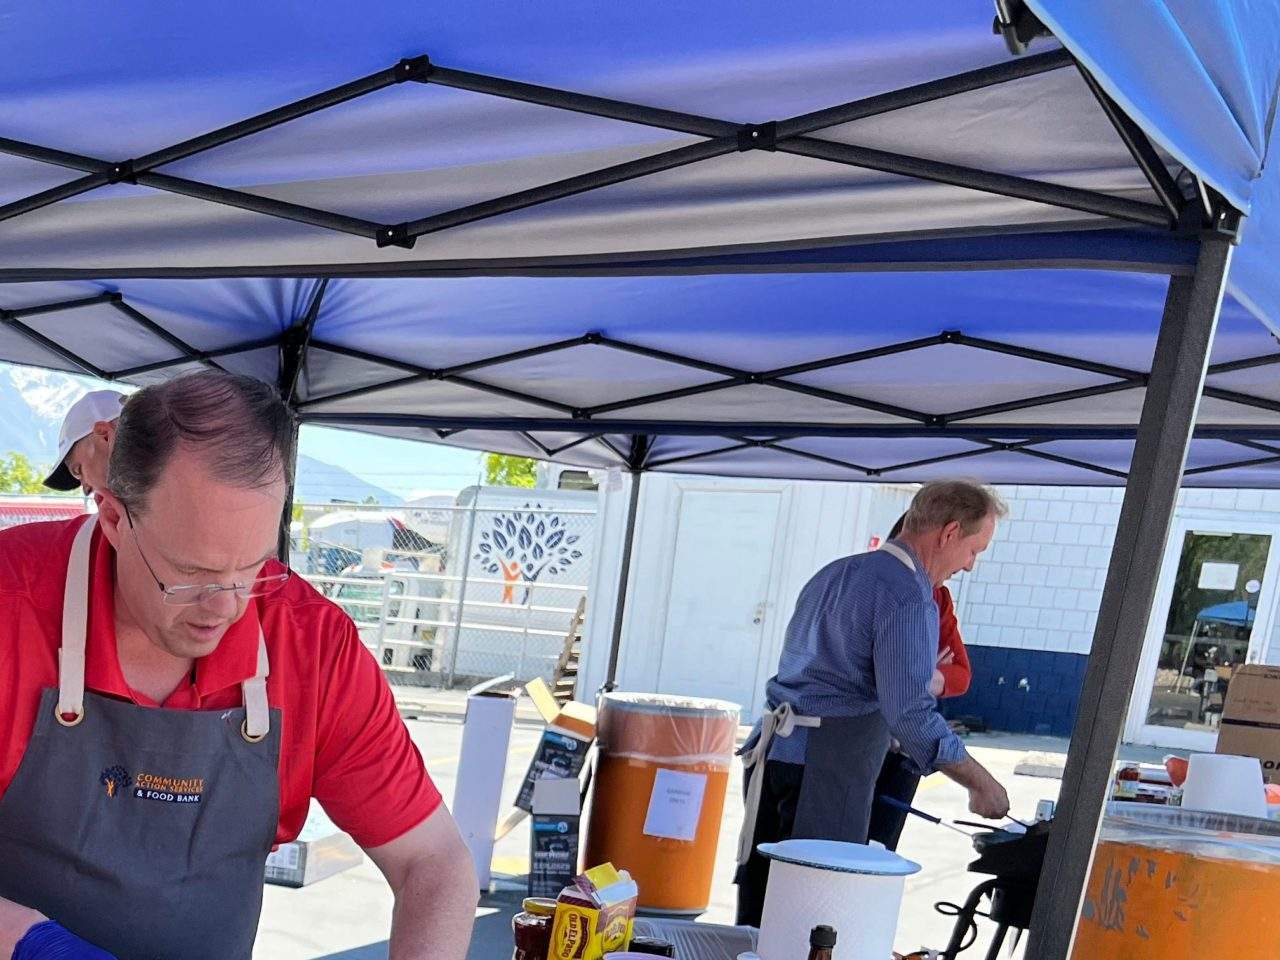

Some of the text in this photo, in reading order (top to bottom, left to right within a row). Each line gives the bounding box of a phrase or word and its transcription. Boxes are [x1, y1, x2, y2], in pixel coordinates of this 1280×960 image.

[137, 773, 204, 787] COMMUNITY
[147, 791, 174, 802] FOOD
[569, 913, 578, 929] OLD
